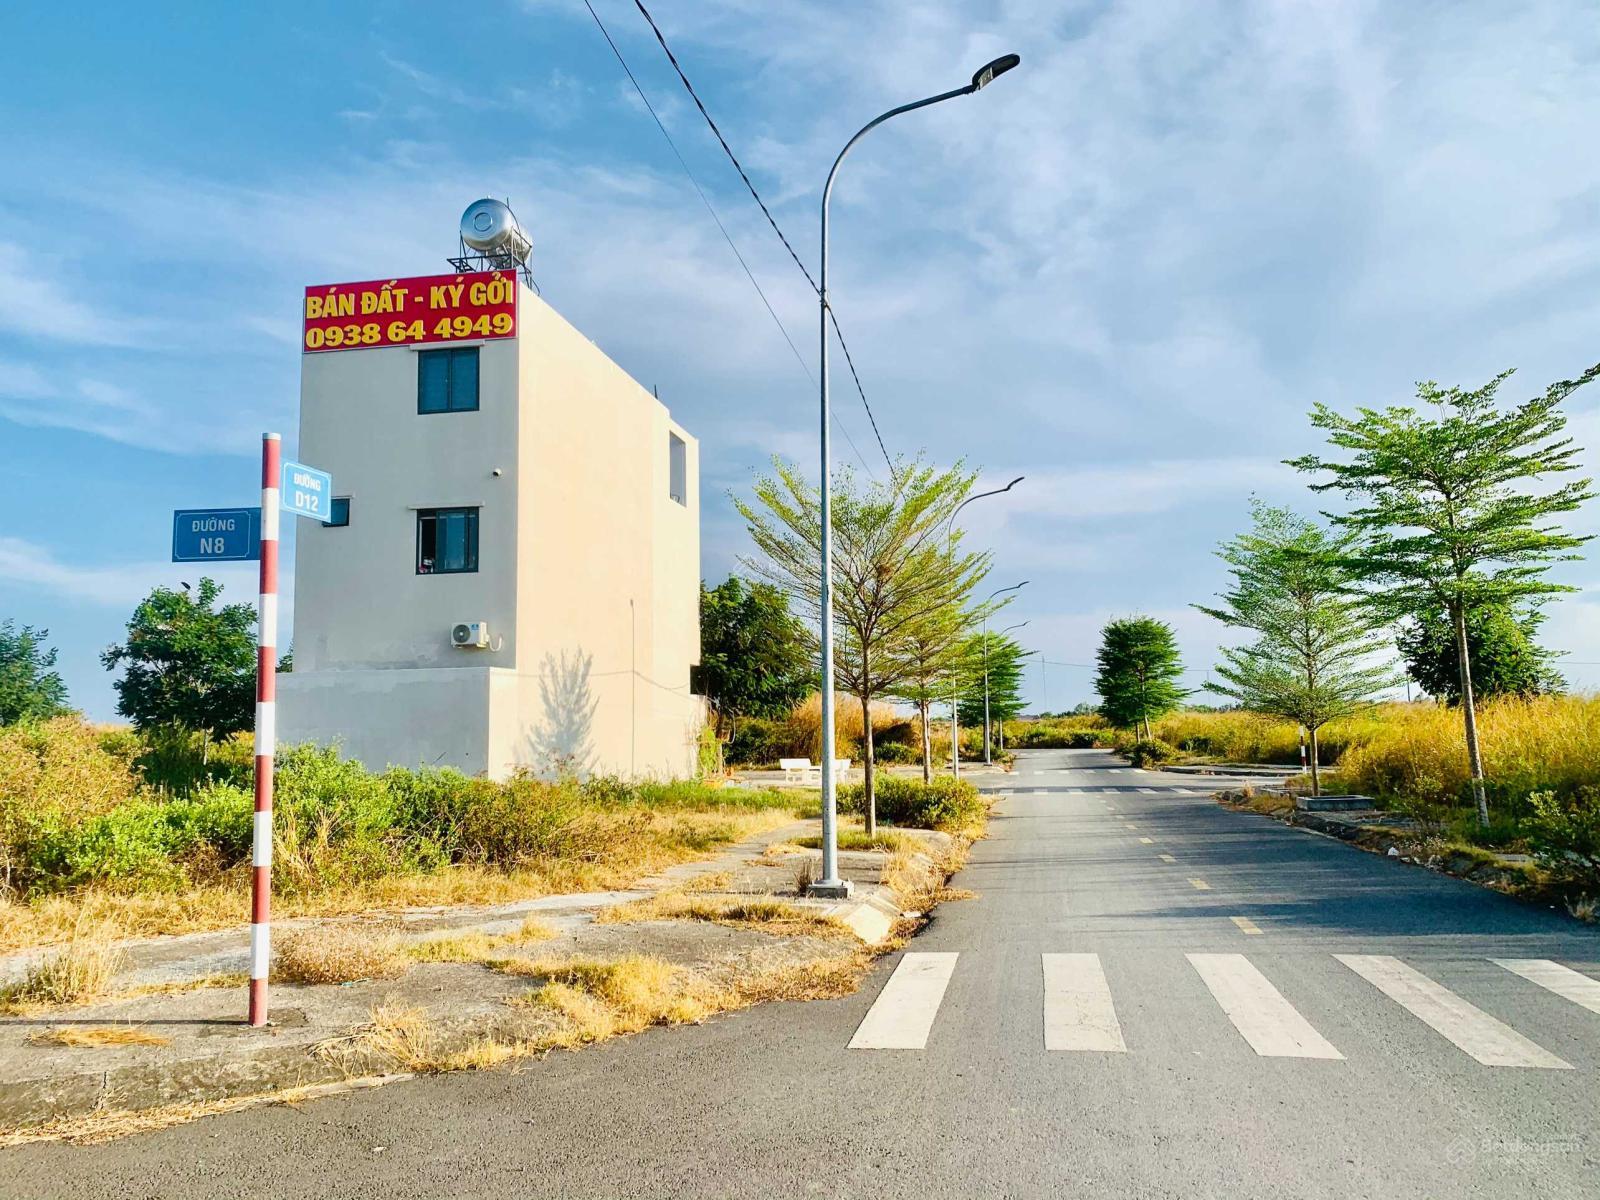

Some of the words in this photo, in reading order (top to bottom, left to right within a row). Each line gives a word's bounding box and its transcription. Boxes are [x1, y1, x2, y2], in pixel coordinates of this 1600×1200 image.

[306, 288, 354, 318] BÁN
[361, 280, 408, 314] ĐẤT
[430, 277, 464, 309] KÝ
[469, 272, 513, 305] GỞI
[306, 323, 381, 348] 0938
[387, 319, 426, 342] 64
[433, 313, 513, 338] 4949
[294, 472, 321, 491] ĐƯỜNG
[295, 491, 319, 512] D12
[192, 517, 235, 532] ĐƯỜNG
[200, 537, 225, 554] N8
